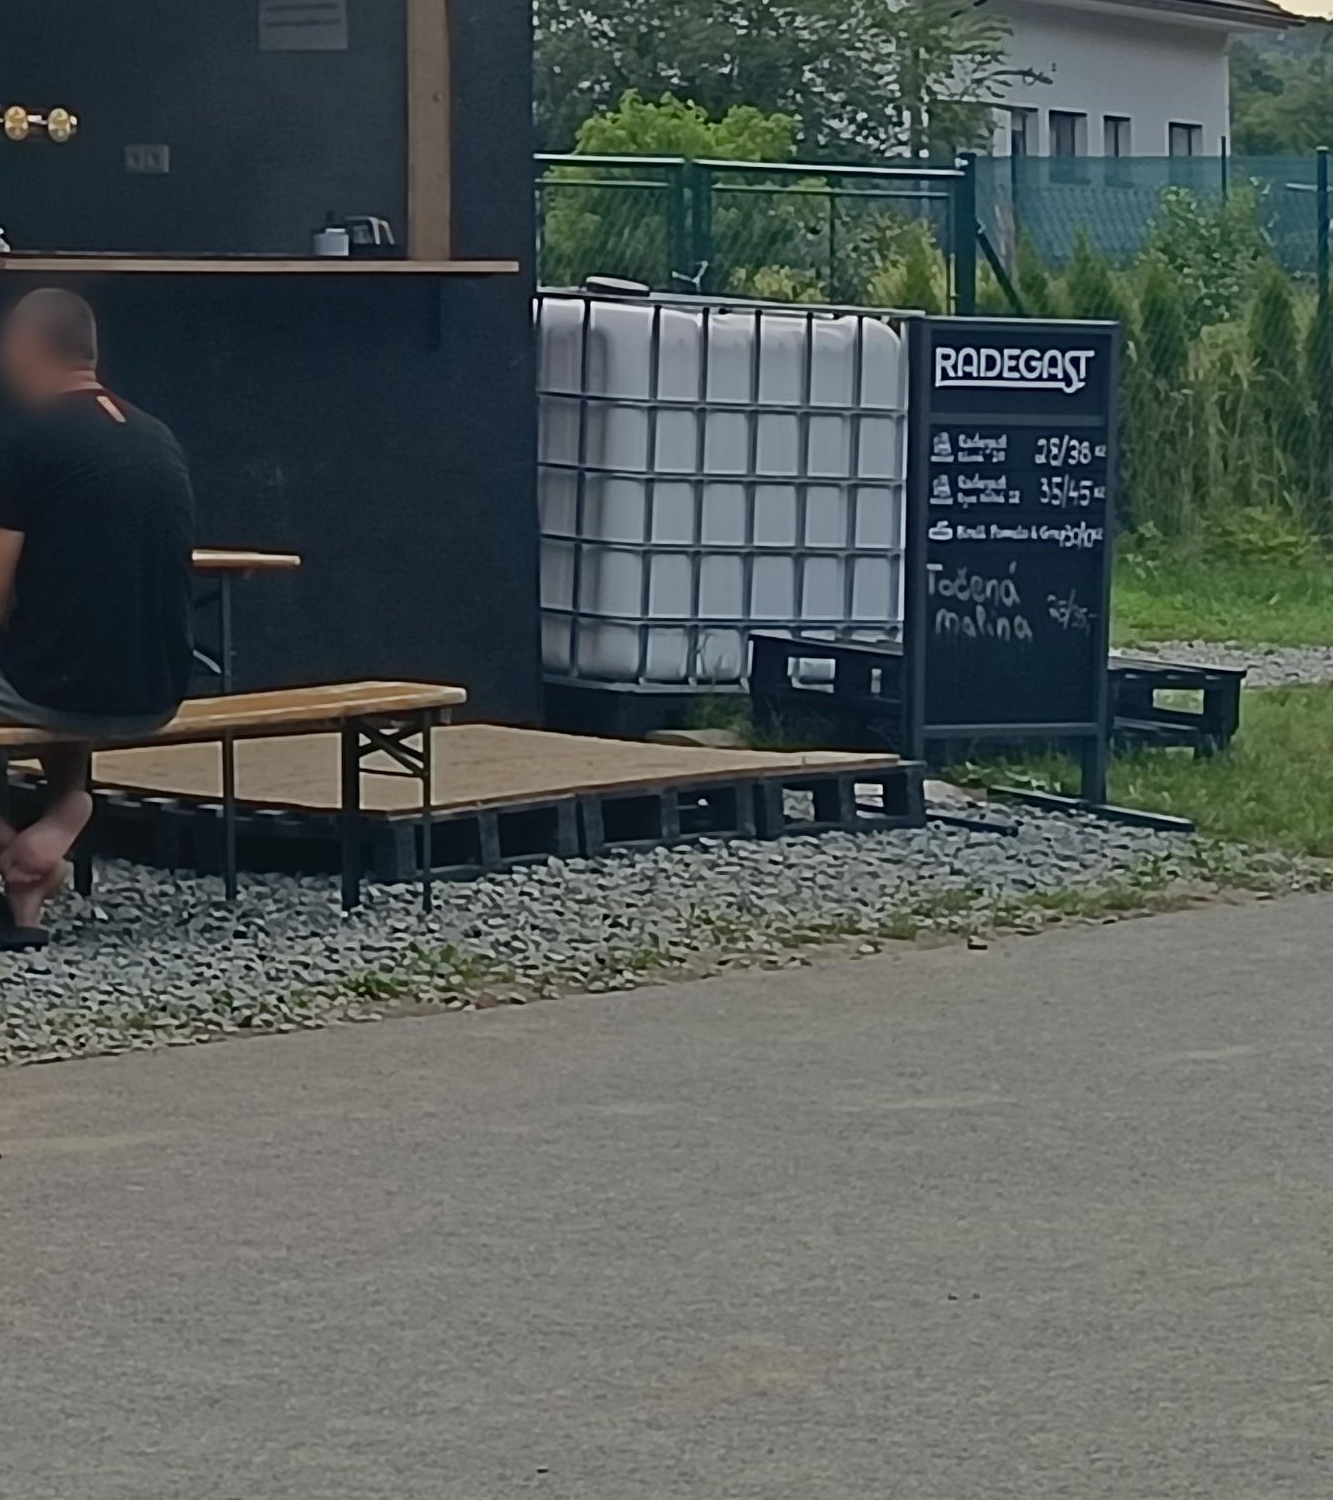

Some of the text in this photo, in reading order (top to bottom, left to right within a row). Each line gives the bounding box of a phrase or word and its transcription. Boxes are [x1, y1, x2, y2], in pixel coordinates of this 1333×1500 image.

[935, 347, 1095, 393] RADEGAST
[1035, 434, 1091, 467] 28/38
[1040, 474, 1093, 508] 35/45
[926, 561, 1020, 608] Točená
[935, 605, 1033, 641] malina
